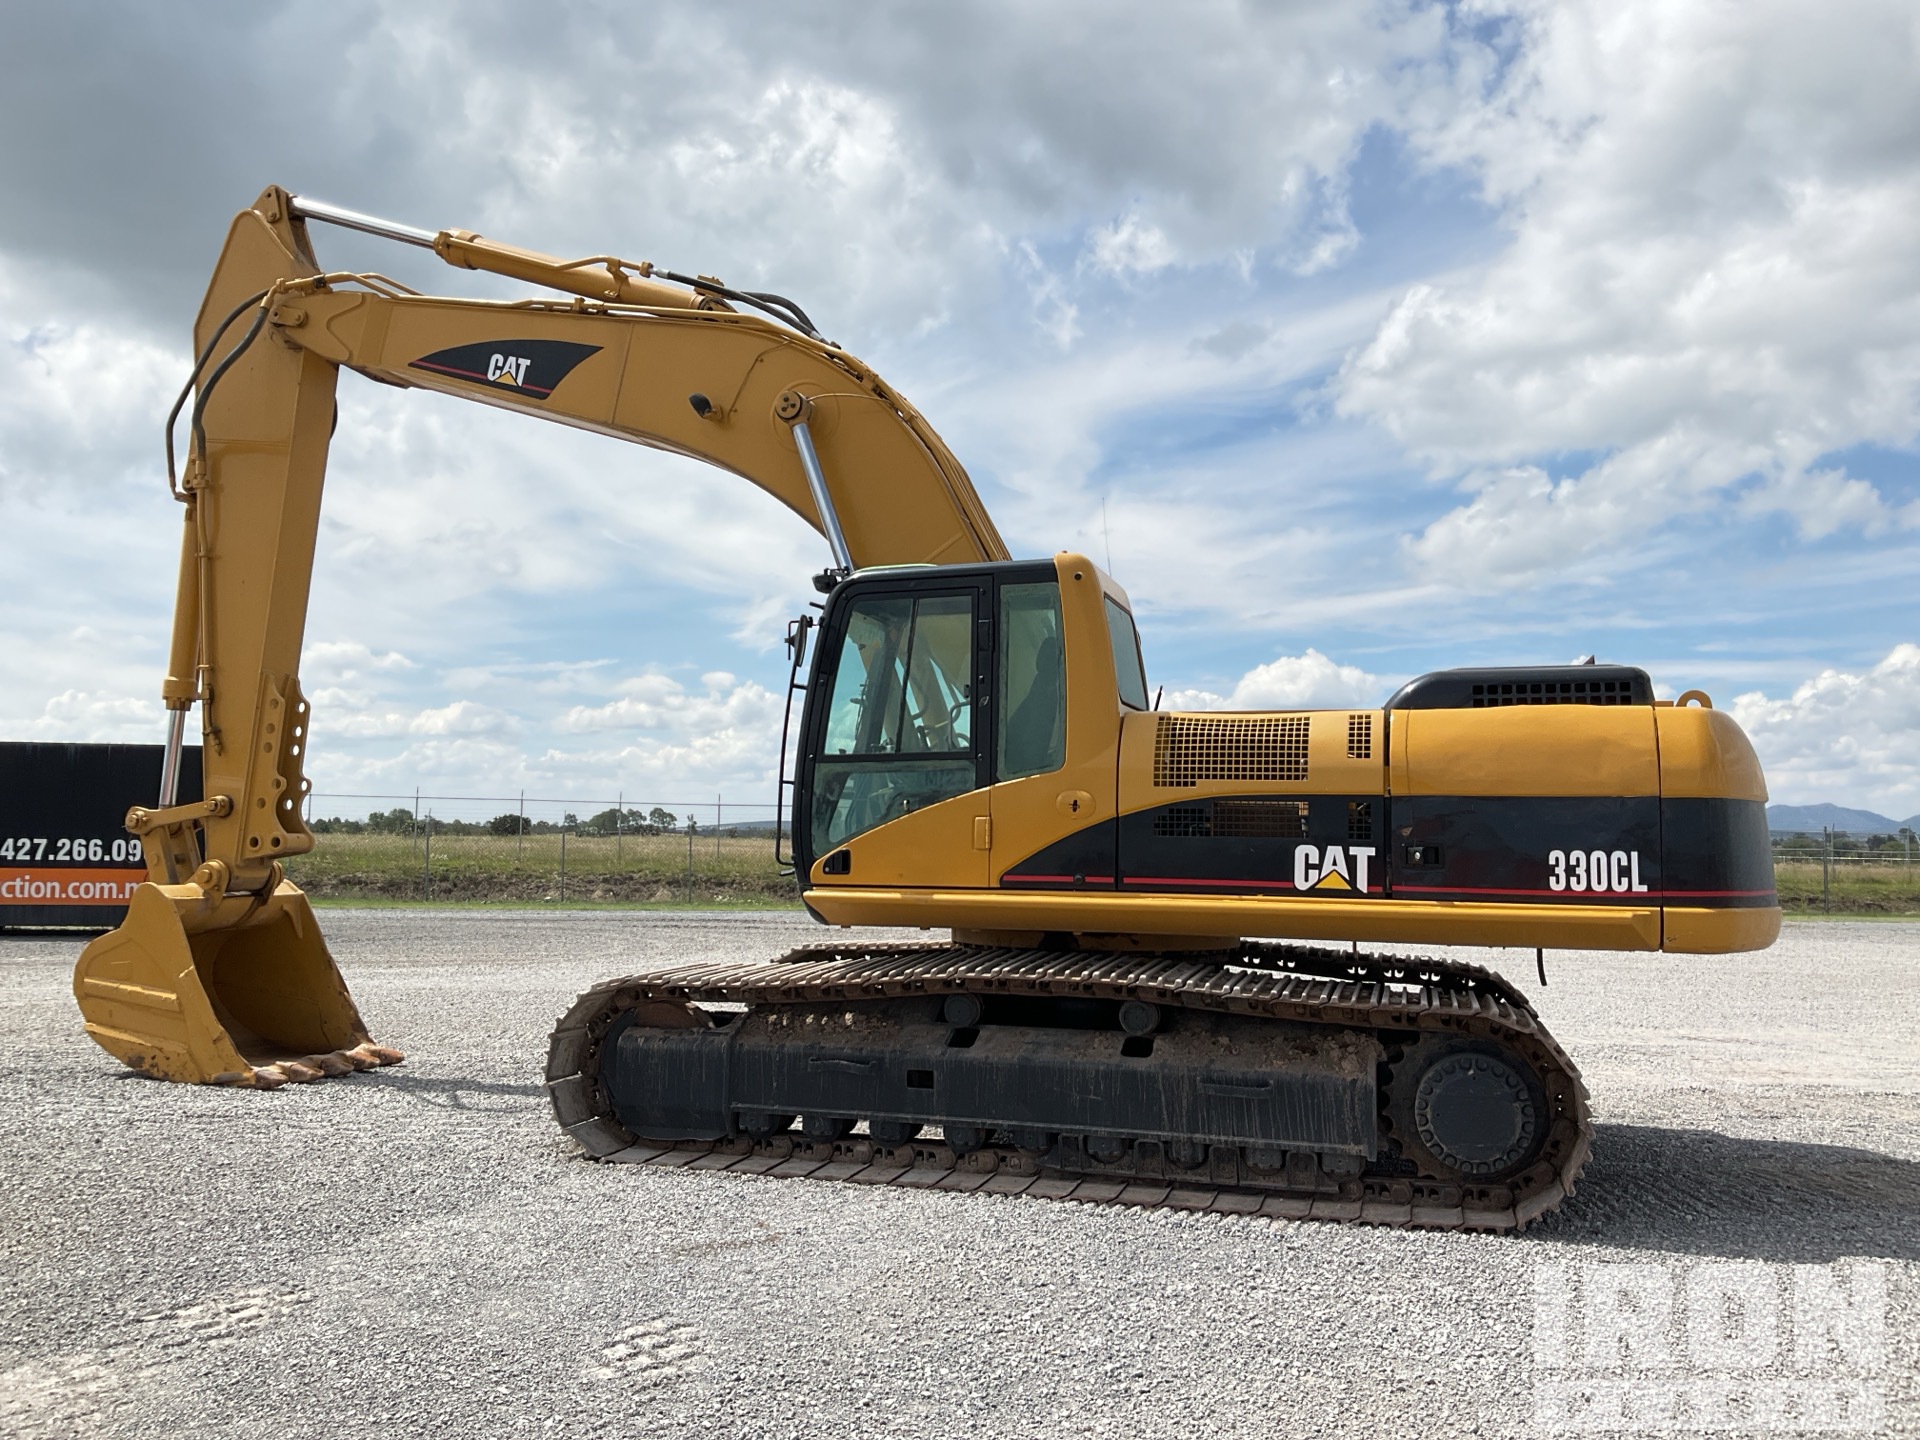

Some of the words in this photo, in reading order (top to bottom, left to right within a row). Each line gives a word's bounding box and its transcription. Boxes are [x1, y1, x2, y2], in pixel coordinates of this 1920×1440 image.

[487, 353, 531, 387] CAT
[1294, 844, 1376, 894] CAT
[1548, 849, 1648, 892] 330CL
